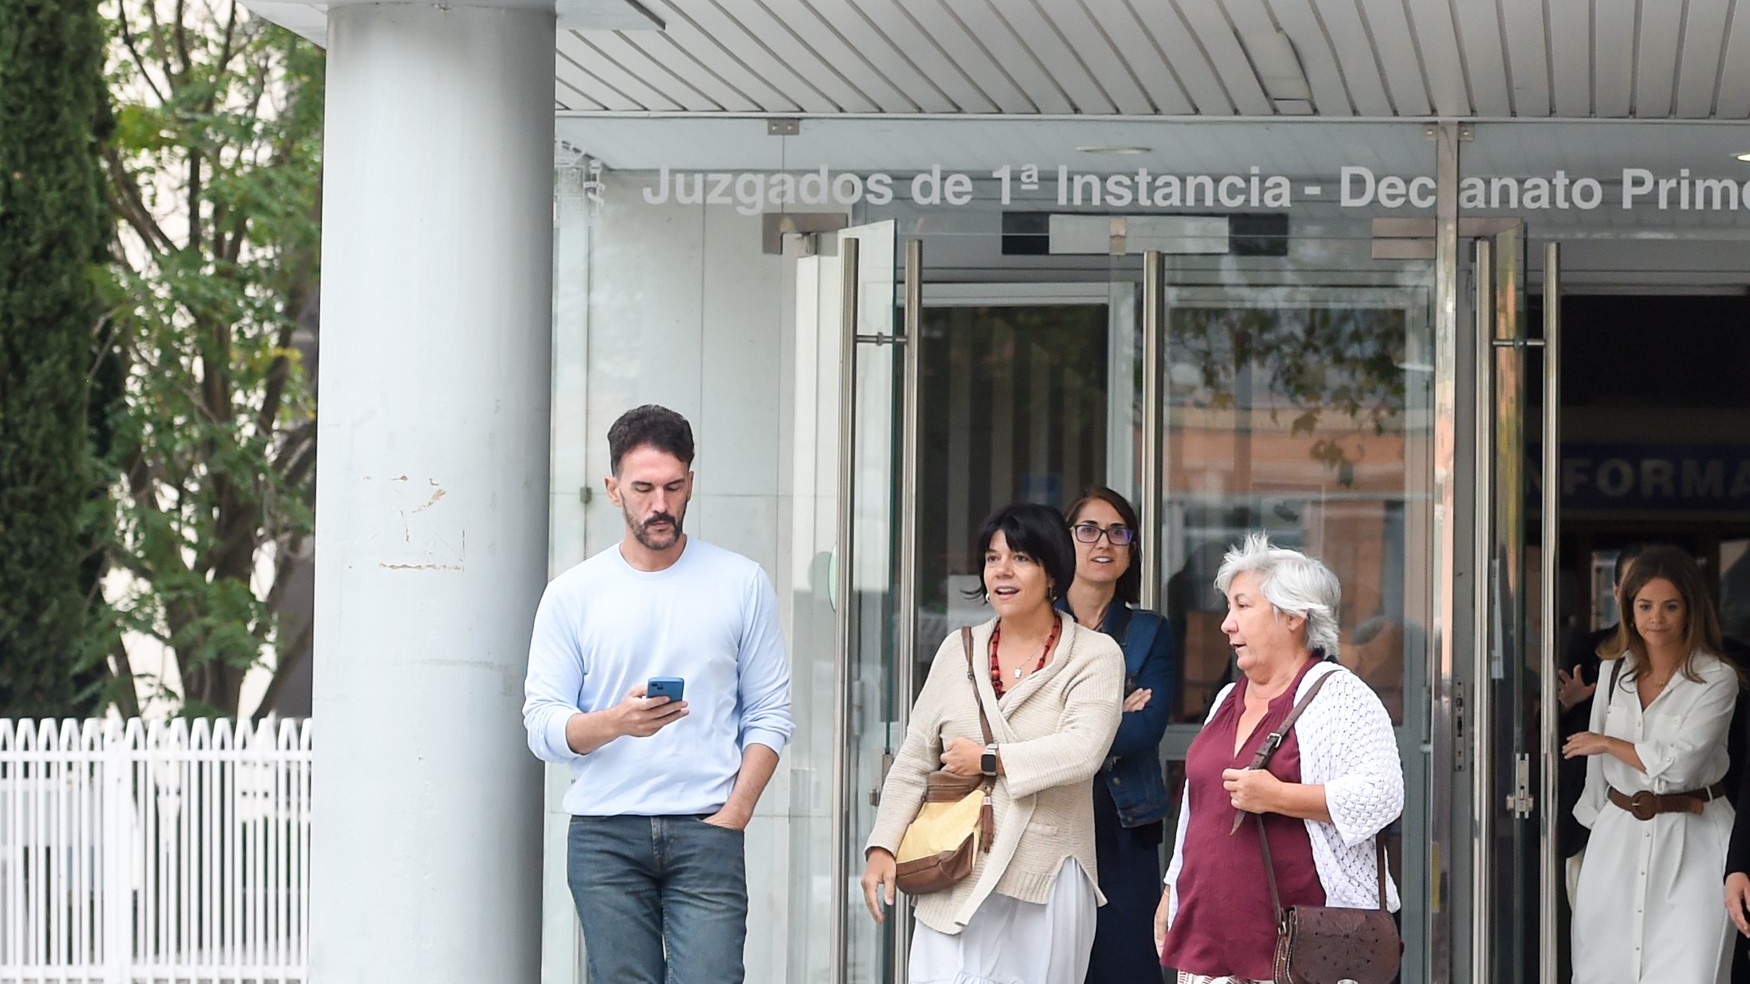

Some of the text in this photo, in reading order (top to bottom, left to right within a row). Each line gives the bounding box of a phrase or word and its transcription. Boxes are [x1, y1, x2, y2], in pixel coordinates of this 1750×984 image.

[642, 164, 894, 215] Juzgados
[911, 165, 973, 206] de
[992, 164, 1040, 205] 1ª
[1057, 165, 1292, 208] Instancia
[1304, 186, 1321, 196] -
